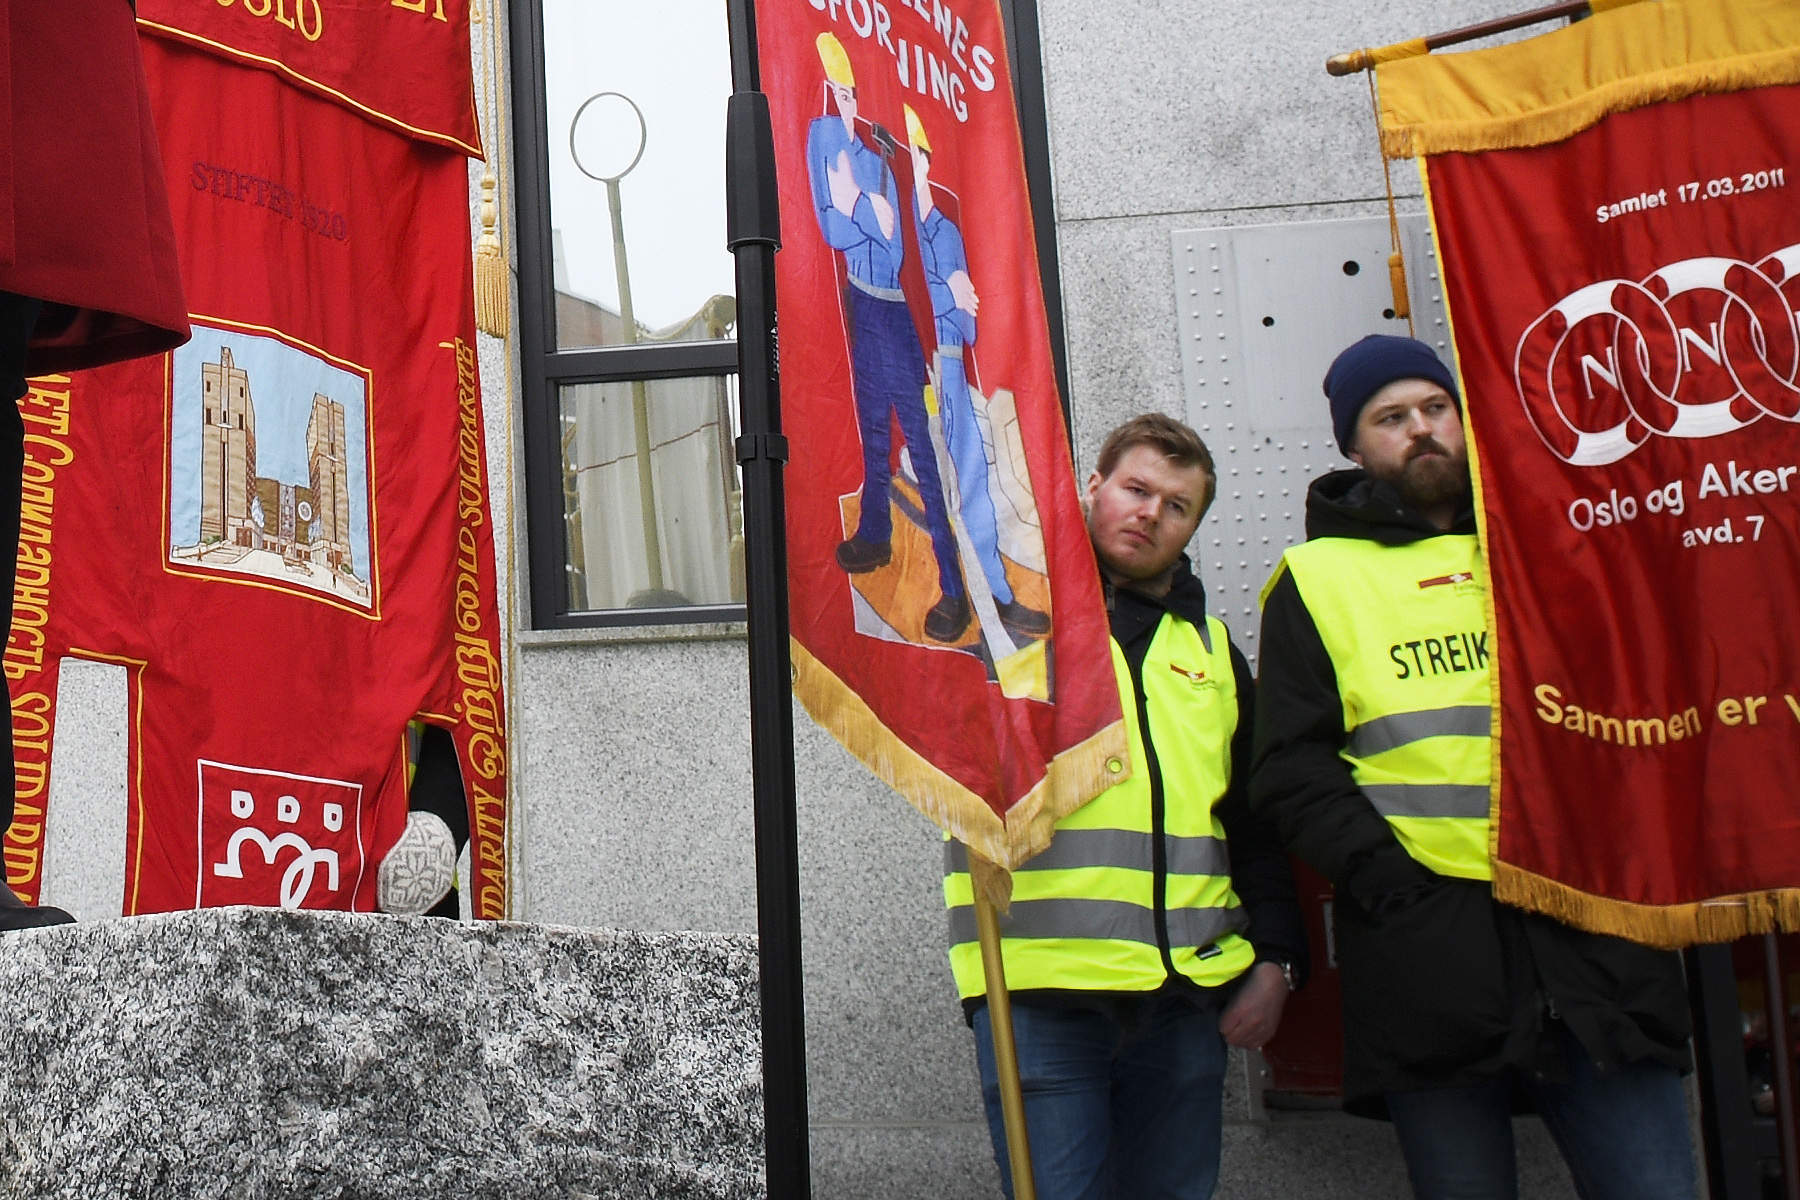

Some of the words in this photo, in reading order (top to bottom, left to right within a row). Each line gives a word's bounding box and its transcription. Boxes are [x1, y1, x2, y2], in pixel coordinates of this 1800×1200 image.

[191, 161, 293, 219] STIFTET
[1596, 188, 1669, 224] Samlet
[1677, 167, 1785, 204] 17.03.2011
[1568, 488, 1638, 532] Oslo
[1646, 479, 1685, 516] og
[1682, 518, 1743, 548] avd.
[1746, 515, 1765, 541] 7
[1390, 631, 1490, 679] STREIK
[1534, 683, 1703, 747] Sammen
[1717, 695, 1767, 726] er
